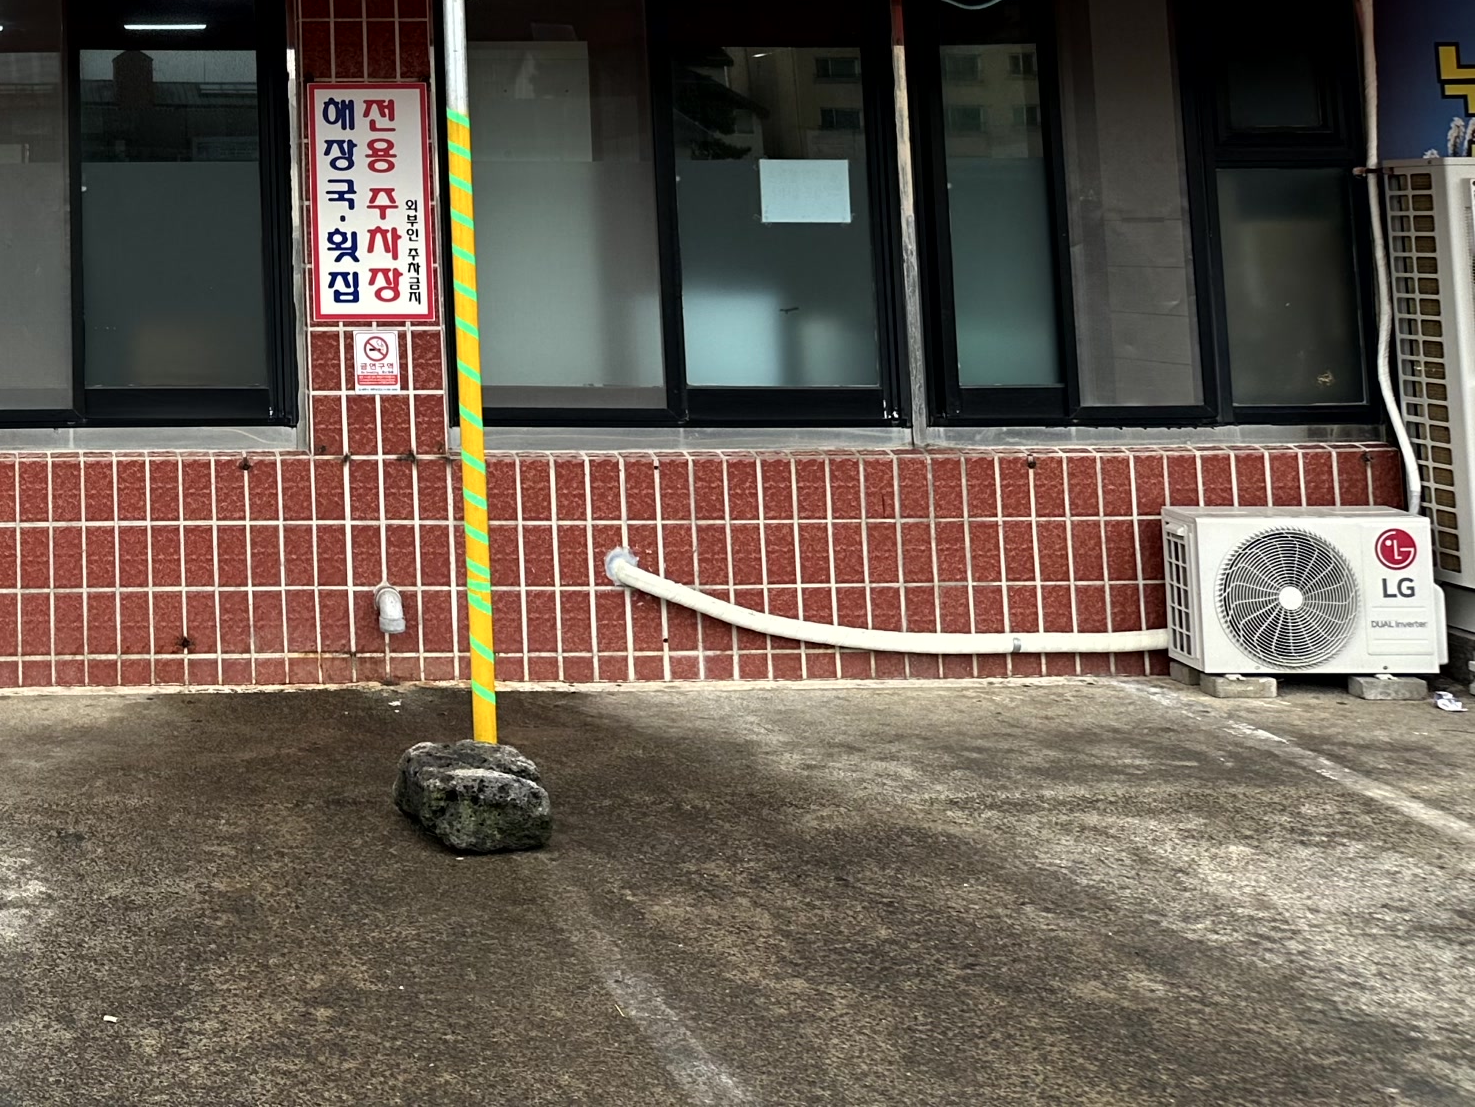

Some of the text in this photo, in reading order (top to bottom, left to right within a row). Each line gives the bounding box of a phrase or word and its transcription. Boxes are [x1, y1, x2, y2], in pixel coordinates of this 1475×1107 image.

[363, 99, 404, 303] 전용 주차장
[405, 199, 421, 305] 외부인 주차금지
[360, 362, 394, 371] 금연구역
[1382, 577, 1416, 598] LG
[1371, 620, 1394, 628] DUAL
